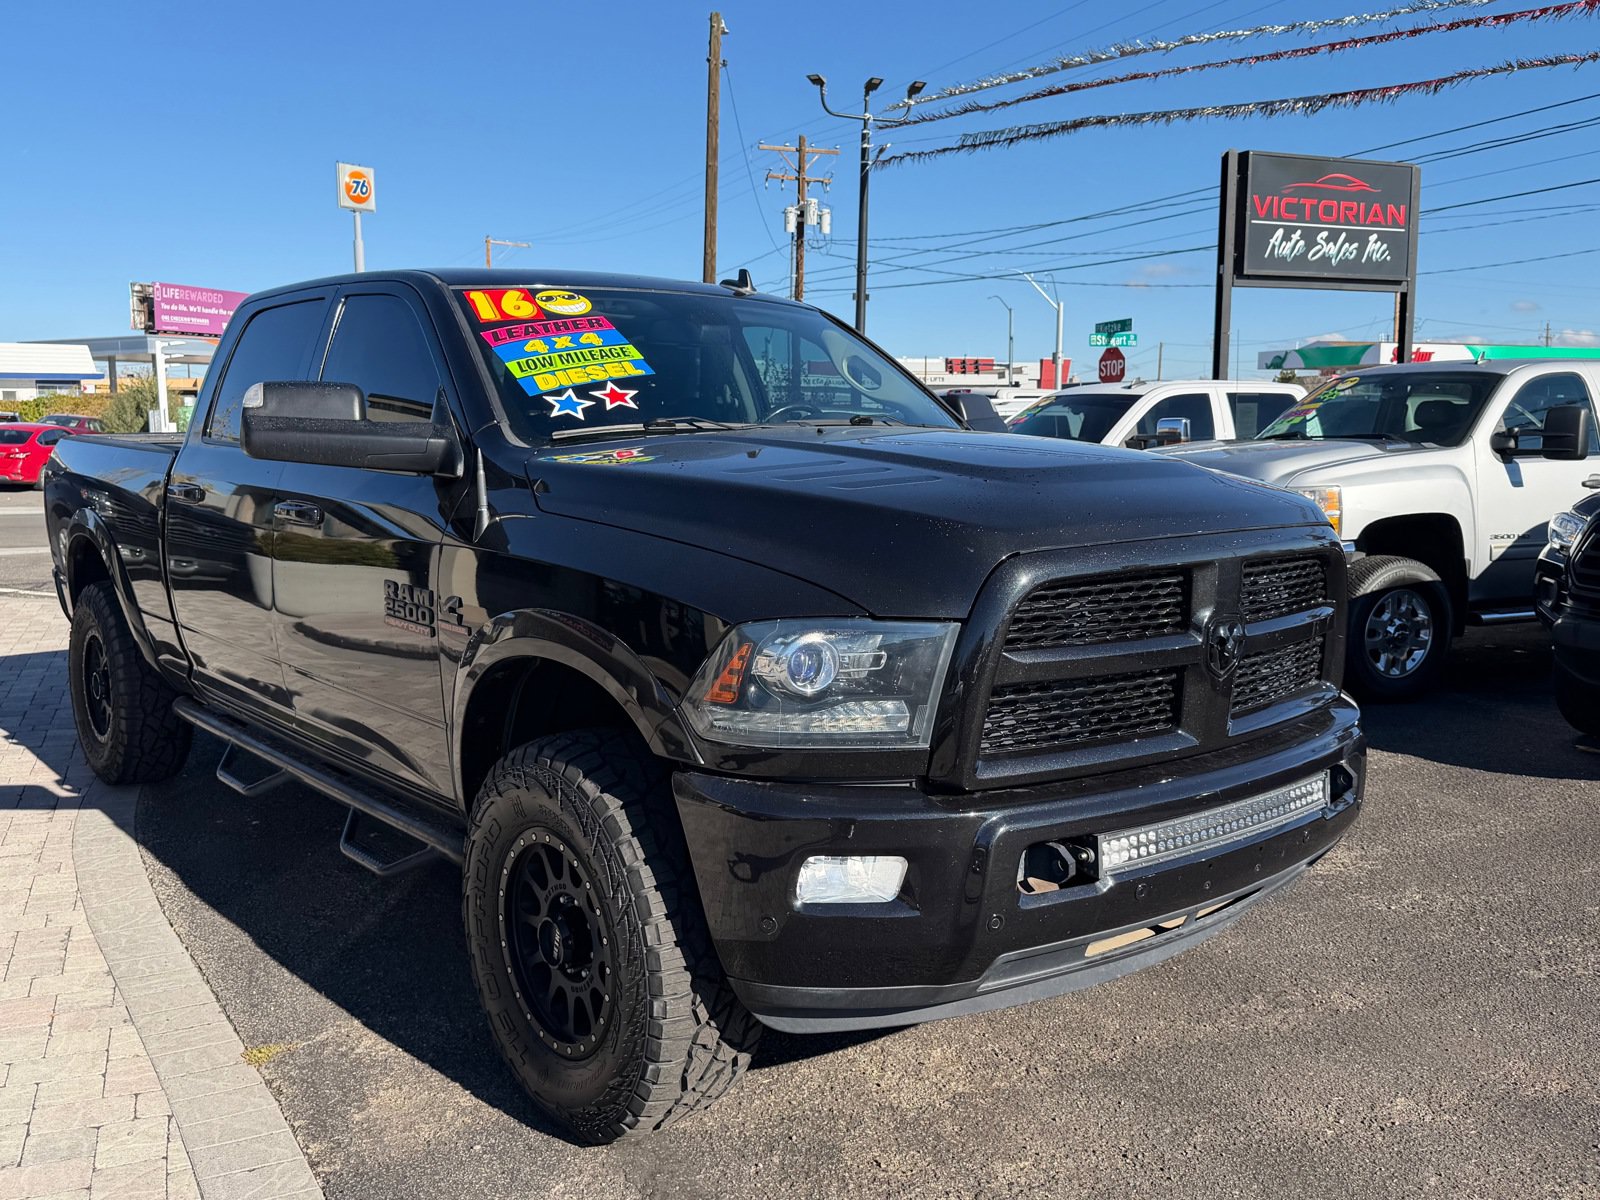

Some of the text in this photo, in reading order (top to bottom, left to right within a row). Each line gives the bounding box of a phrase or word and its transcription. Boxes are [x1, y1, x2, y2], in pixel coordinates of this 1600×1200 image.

[352, 179, 369, 195] 76
[1253, 194, 1407, 226] VICTORIAN
[1264, 228, 1392, 266] Auto Sales Inc.
[161, 302, 171, 310] You
[470, 290, 538, 320] 16
[491, 316, 605, 342] LEATHER
[516, 346, 632, 373] LOW MILEAGE
[1100, 359, 1124, 376] STOP
[533, 361, 646, 391] DIESEL
[384, 579, 434, 608] RAM
[384, 597, 434, 625] 2500
